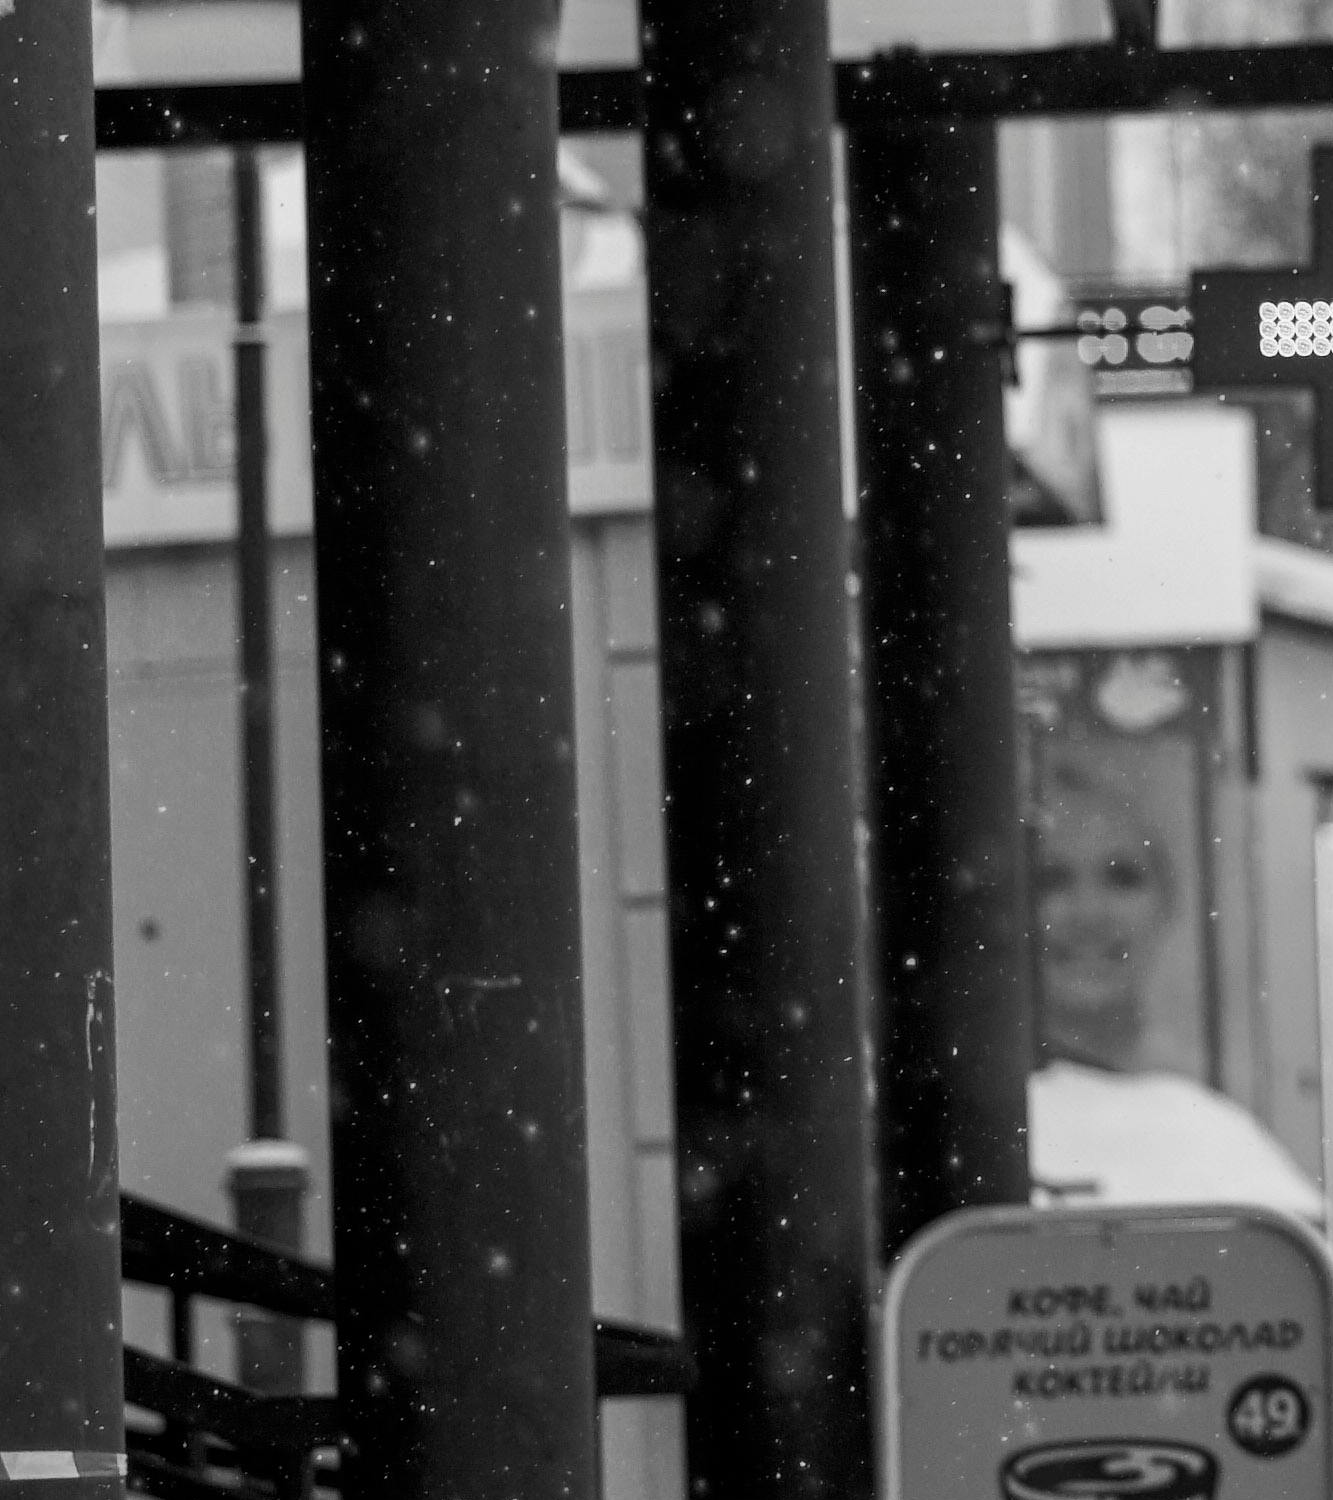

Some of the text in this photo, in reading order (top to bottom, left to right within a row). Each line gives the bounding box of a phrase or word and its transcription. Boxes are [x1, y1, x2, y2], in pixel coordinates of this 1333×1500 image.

[1134, 1275, 1213, 1313] ЧАЙ
[917, 1319, 1304, 1361] ГОРЯЧИЙ ШОКОЛАД
[1012, 1359, 1211, 1398] КОКТЕЙЛИ
[1235, 1388, 1297, 1438] 49
